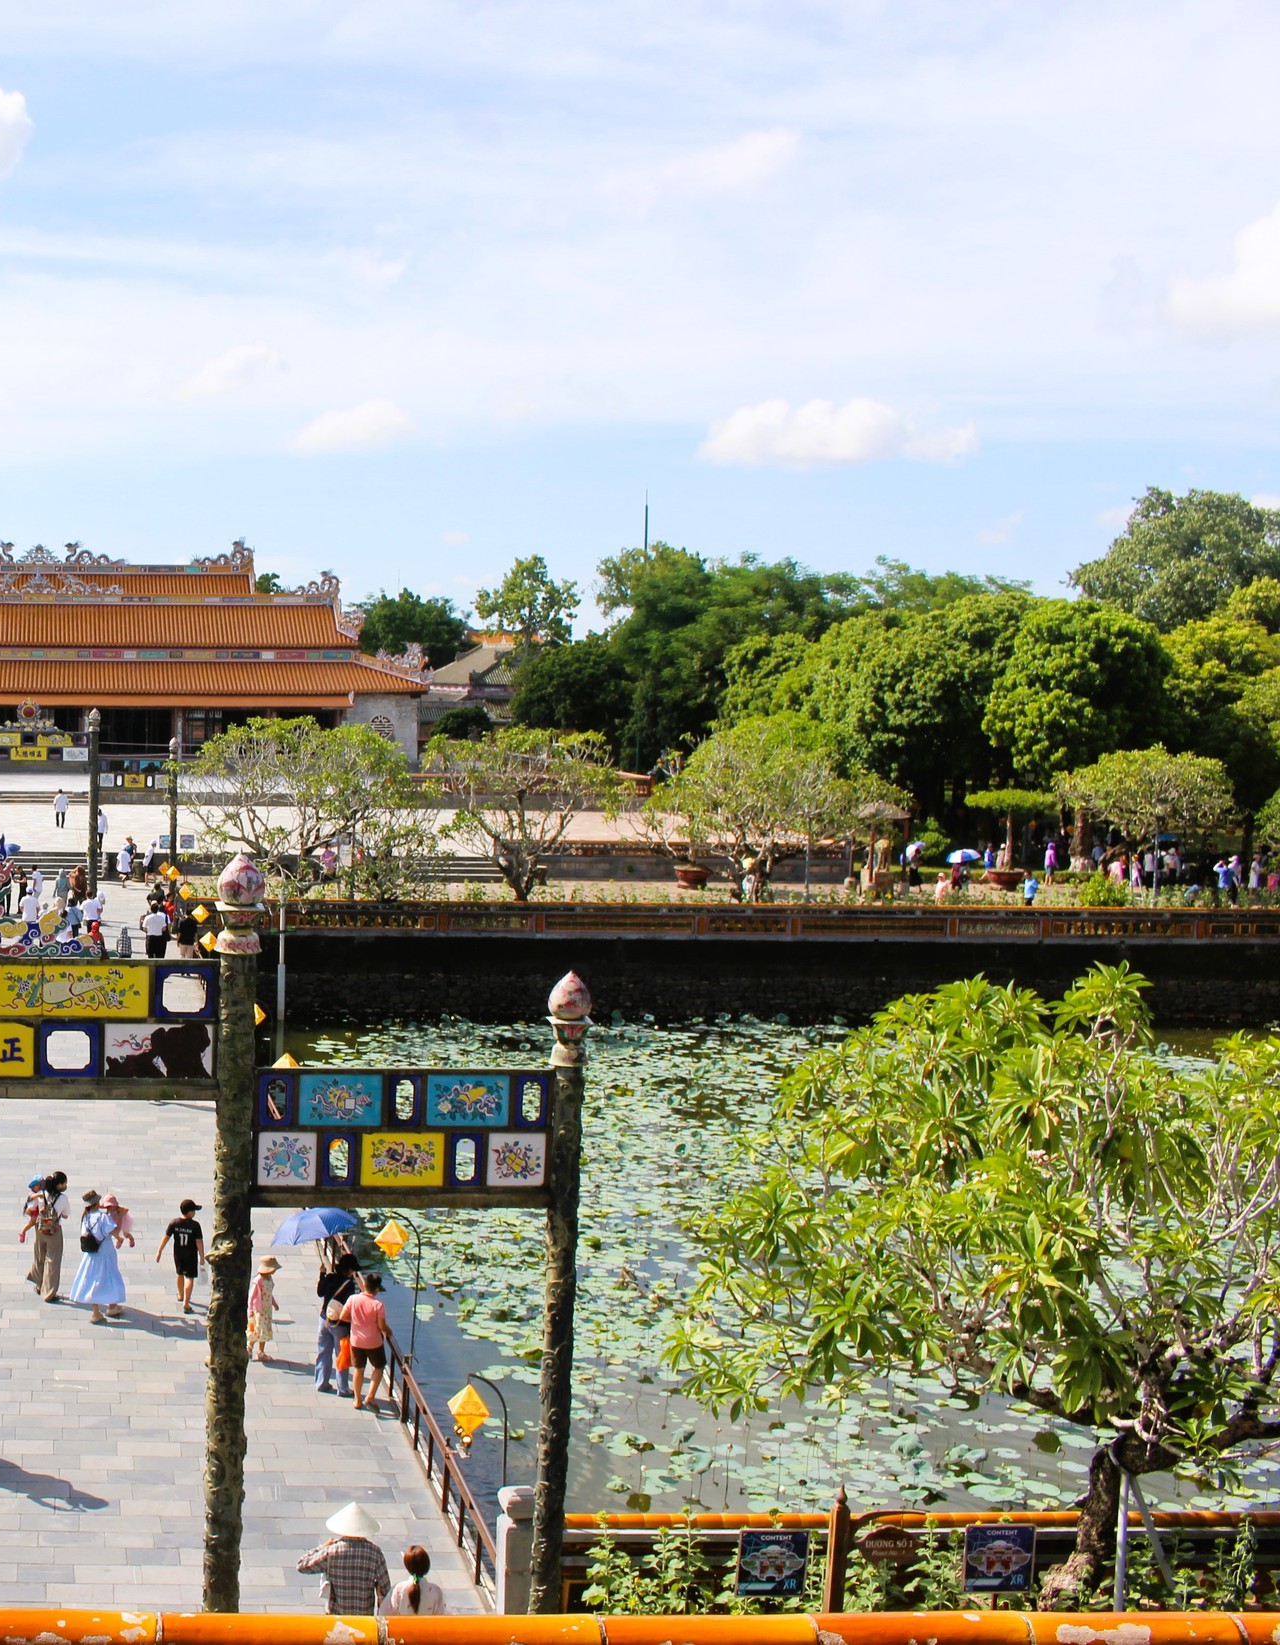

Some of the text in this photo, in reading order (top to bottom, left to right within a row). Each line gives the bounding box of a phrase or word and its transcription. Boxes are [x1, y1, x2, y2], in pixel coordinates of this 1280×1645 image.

[179, 1233, 188, 1246] 11
[909, 1540, 913, 1548] 1
[783, 1578, 797, 1590] XR
[1010, 1574, 1025, 1586] XR
